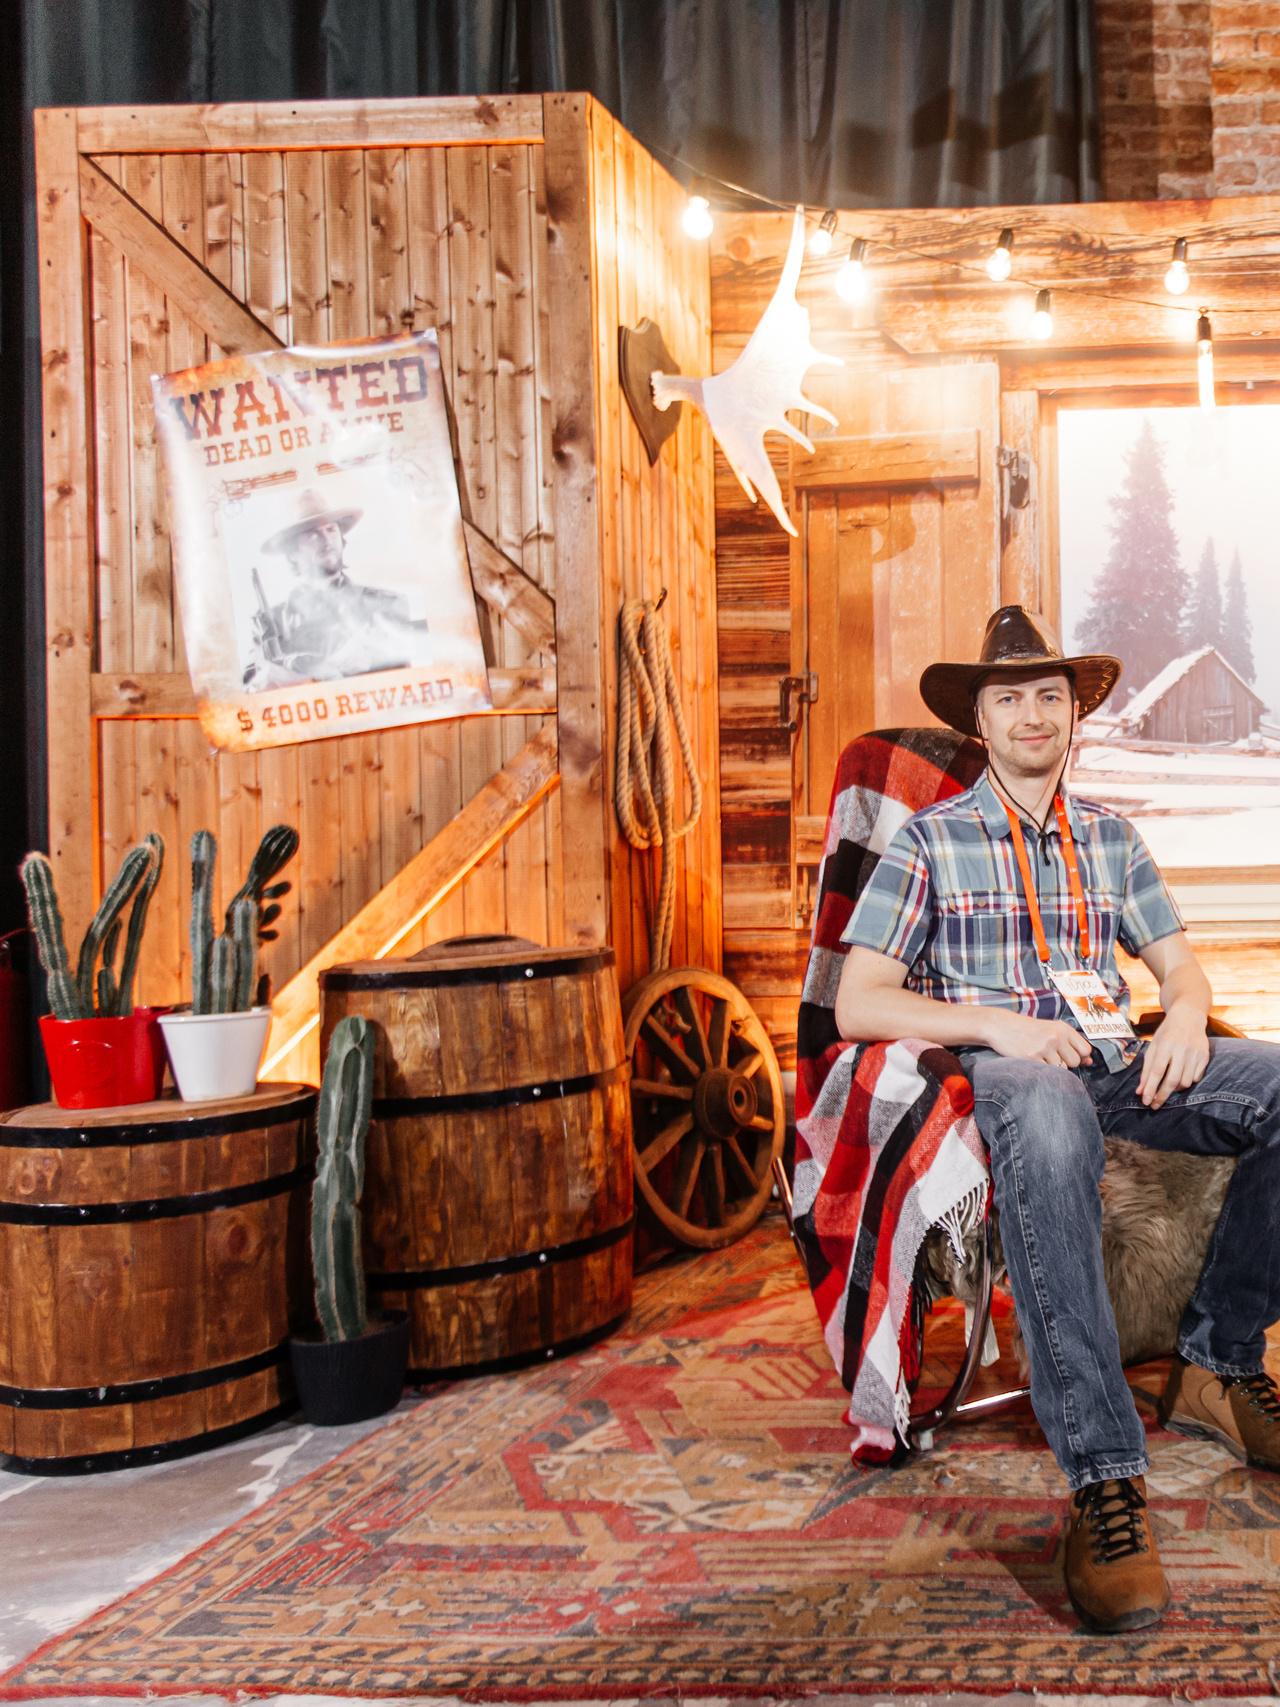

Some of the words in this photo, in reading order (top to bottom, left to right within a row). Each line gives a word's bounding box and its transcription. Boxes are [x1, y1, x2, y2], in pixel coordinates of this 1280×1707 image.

[169, 356, 429, 441] WANTED
[204, 433, 272, 467] DEAD
[279, 425, 311, 453] OR
[237, 707, 254, 733] $
[261, 698, 329, 729] 4000
[335, 678, 454, 717] REWARD
